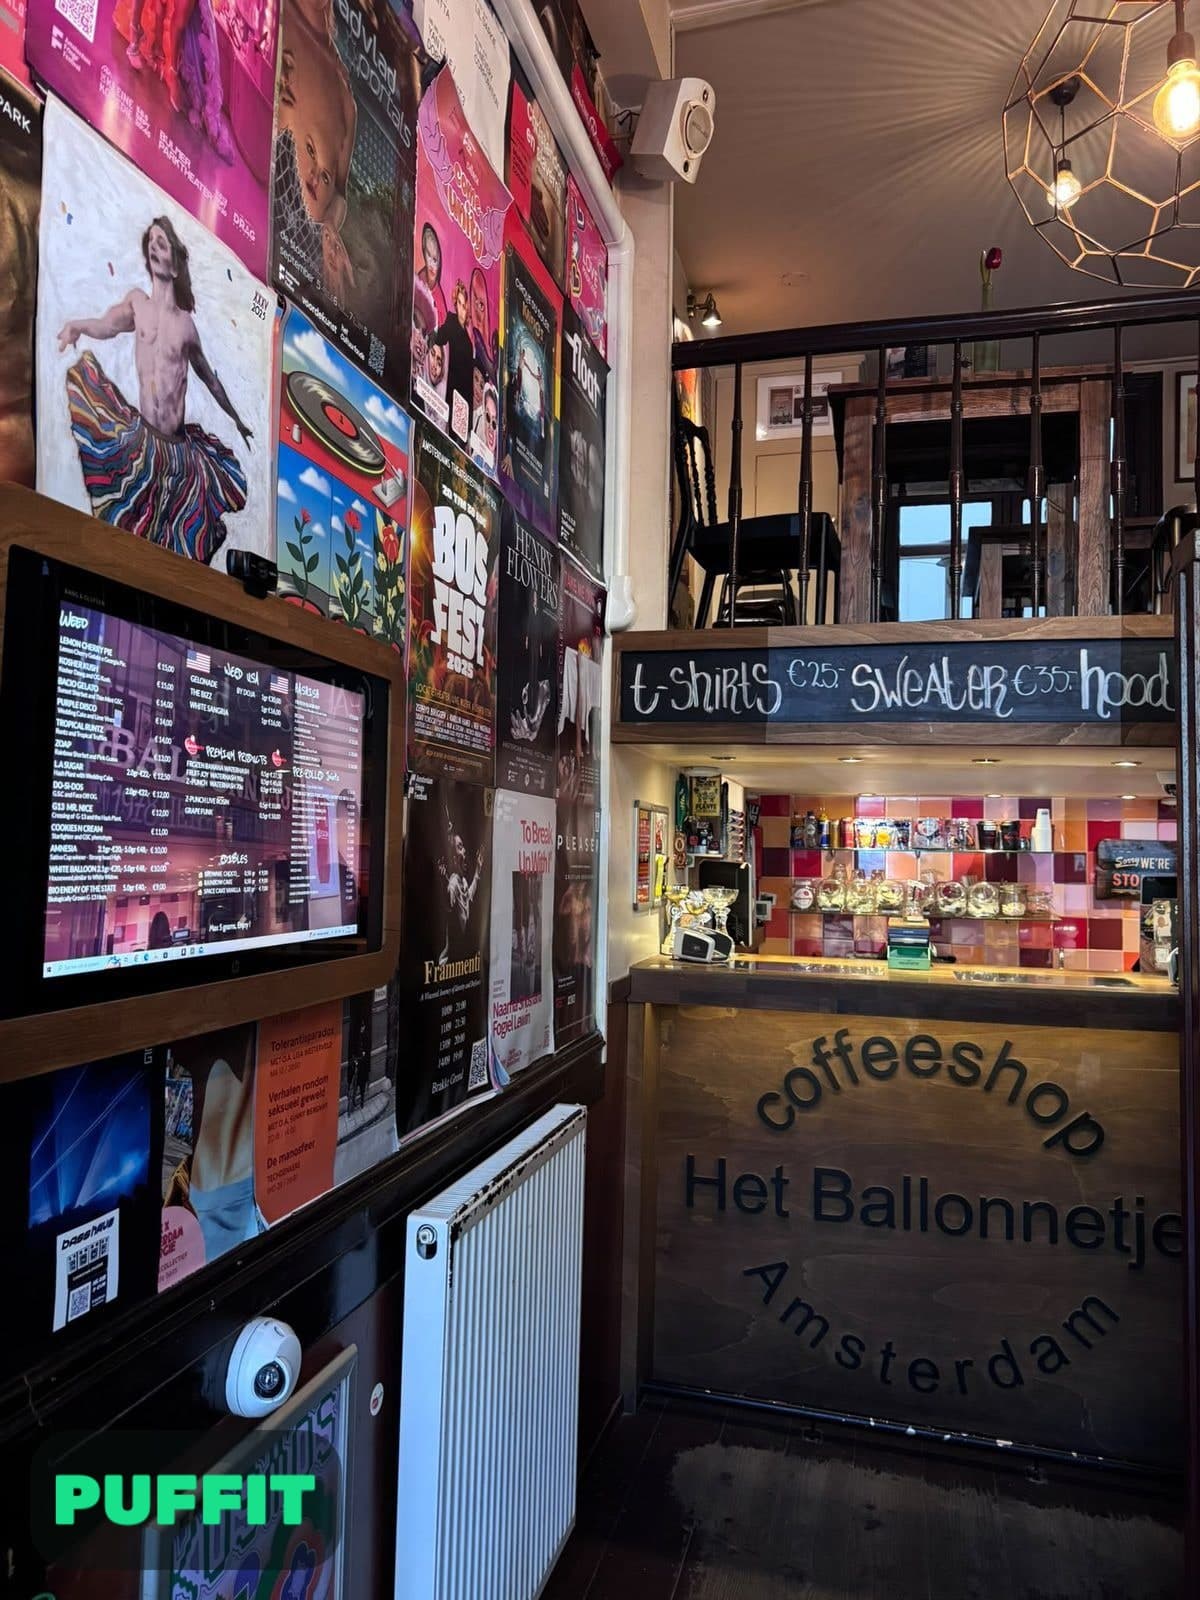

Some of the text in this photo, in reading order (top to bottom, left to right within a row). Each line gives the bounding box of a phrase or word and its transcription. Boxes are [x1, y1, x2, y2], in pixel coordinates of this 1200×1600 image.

[279, 246, 315, 283] september
[432, 505, 489, 607] BOS
[513, 522, 554, 578] HENRY
[506, 544, 560, 611] FLOWERS
[60, 635, 113, 657] LEMON CHERRY PIE
[59, 656, 80, 669] KOSHER
[446, 651, 475, 680] 2025
[223, 662, 260, 686] WEED USA
[57, 676, 99, 693] BACIO GELATO
[190, 687, 201, 698] THE
[57, 697, 98, 713] PURPLE DISCO
[189, 701, 207, 713] WHITE
[56, 718, 105, 734] TROPICAL RUNTZ
[63, 761, 84, 771] SUGAR
[52, 780, 84, 792] DO-SI-DOS
[78, 804, 94, 813] NICE
[50, 824, 79, 833] COOKIES
[83, 825, 103, 833] CREAM
[520, 820, 553, 845] To Break
[49, 865, 97, 873] WHITE BALLOON
[519, 851, 531, 880] Up
[1114, 856, 1170, 870] Sorry WE'RE
[58, 885, 81, 894] ENEMY
[102, 884, 117, 892] STATE
[1112, 872, 1141, 888] STO
[424, 950, 481, 985] Frammenti
[268, 1074, 329, 1104] Verhalen rondom
[756, 1028, 1106, 1157] coffeeshop
[268, 1097, 300, 1118] seksueel
[266, 1157, 278, 1170] De
[686, 1154, 1184, 1270] Het Ballonnetje
[741, 1260, 1121, 1396] Amsterdam
